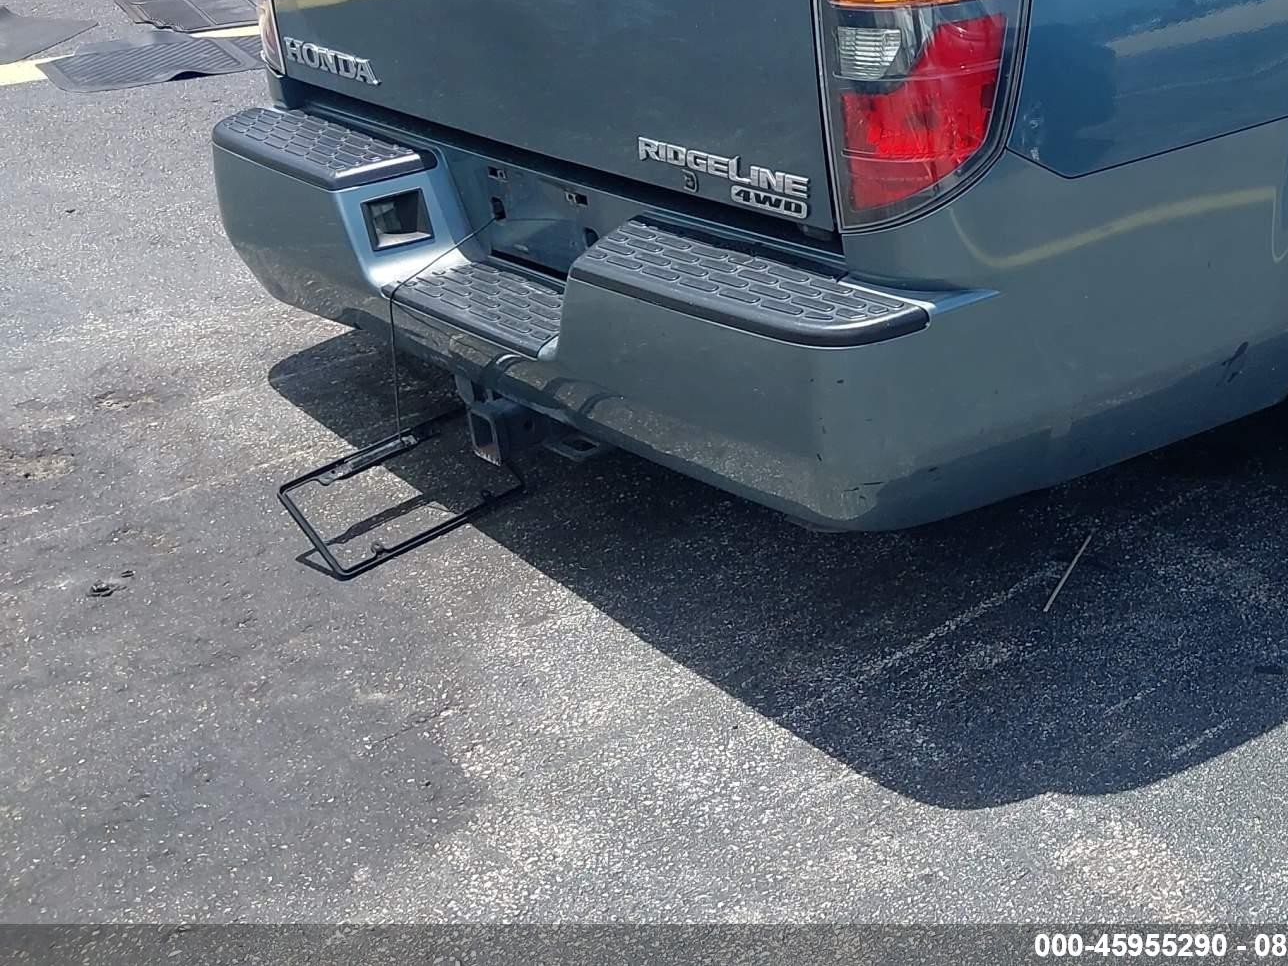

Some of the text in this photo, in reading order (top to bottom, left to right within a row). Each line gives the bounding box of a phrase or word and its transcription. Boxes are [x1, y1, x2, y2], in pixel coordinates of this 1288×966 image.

[283, 36, 381, 85] HONDA
[637, 136, 811, 199] RIDGELINE
[733, 187, 804, 215] 4WD
